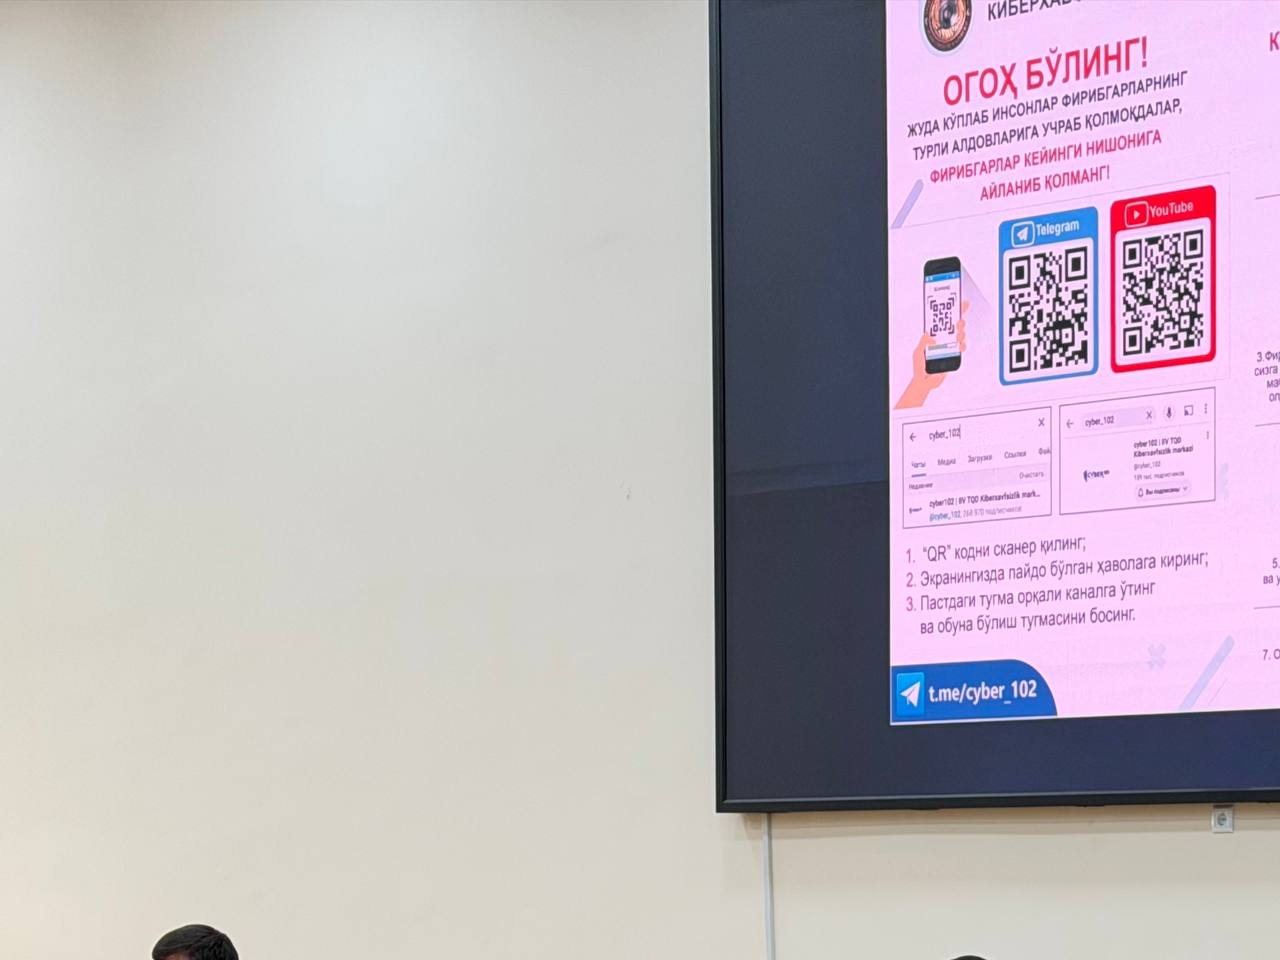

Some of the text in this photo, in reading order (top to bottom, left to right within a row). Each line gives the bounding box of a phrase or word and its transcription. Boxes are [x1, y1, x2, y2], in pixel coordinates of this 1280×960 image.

[944, 36, 1148, 106] ОГОҲ БЎЛИНГ!
[907, 70, 1187, 137] ЖУДА КЎПЛАБ ИНСОНЛАР ФИРИБГАРЛАРНИНГ
[912, 98, 1182, 160] ТУРЛИ АЛДОВЛАРИГА УЧРАБ ҚОЛМОҚДАЛАР,
[929, 129, 1161, 182] ФИРИБГАРЛАР КЕЙИНГИ НИШОНИГА
[980, 165, 1109, 200] АЙЛАНИБ ҚОЛМАНГ!
[1149, 200, 1194, 218] YouTube
[1035, 220, 1080, 238] Telegram
[1254, 365, 1278, 376] сизга
[928, 427, 960, 441] cyber_102
[1084, 415, 1115, 428] cyber_102
[905, 548, 915, 563] 1.
[954, 545, 989, 561] кодни
[993, 540, 1036, 557] сканер
[1040, 537, 1085, 554] қилинг;
[1272, 557, 1280, 568] 5.
[906, 552, 1208, 588] 2. Экранингизда пайдо бўлган ҳаволага киринг;
[1262, 574, 1273, 584] ва
[905, 580, 1155, 611] 3. Пастдаги тугма орқали каналга ўтинг
[920, 606, 1135, 636] ва обуна бўлиш тугмасини босинг.
[1262, 648, 1271, 660] 7.
[928, 679, 1037, 704] t.me/cyber_102
